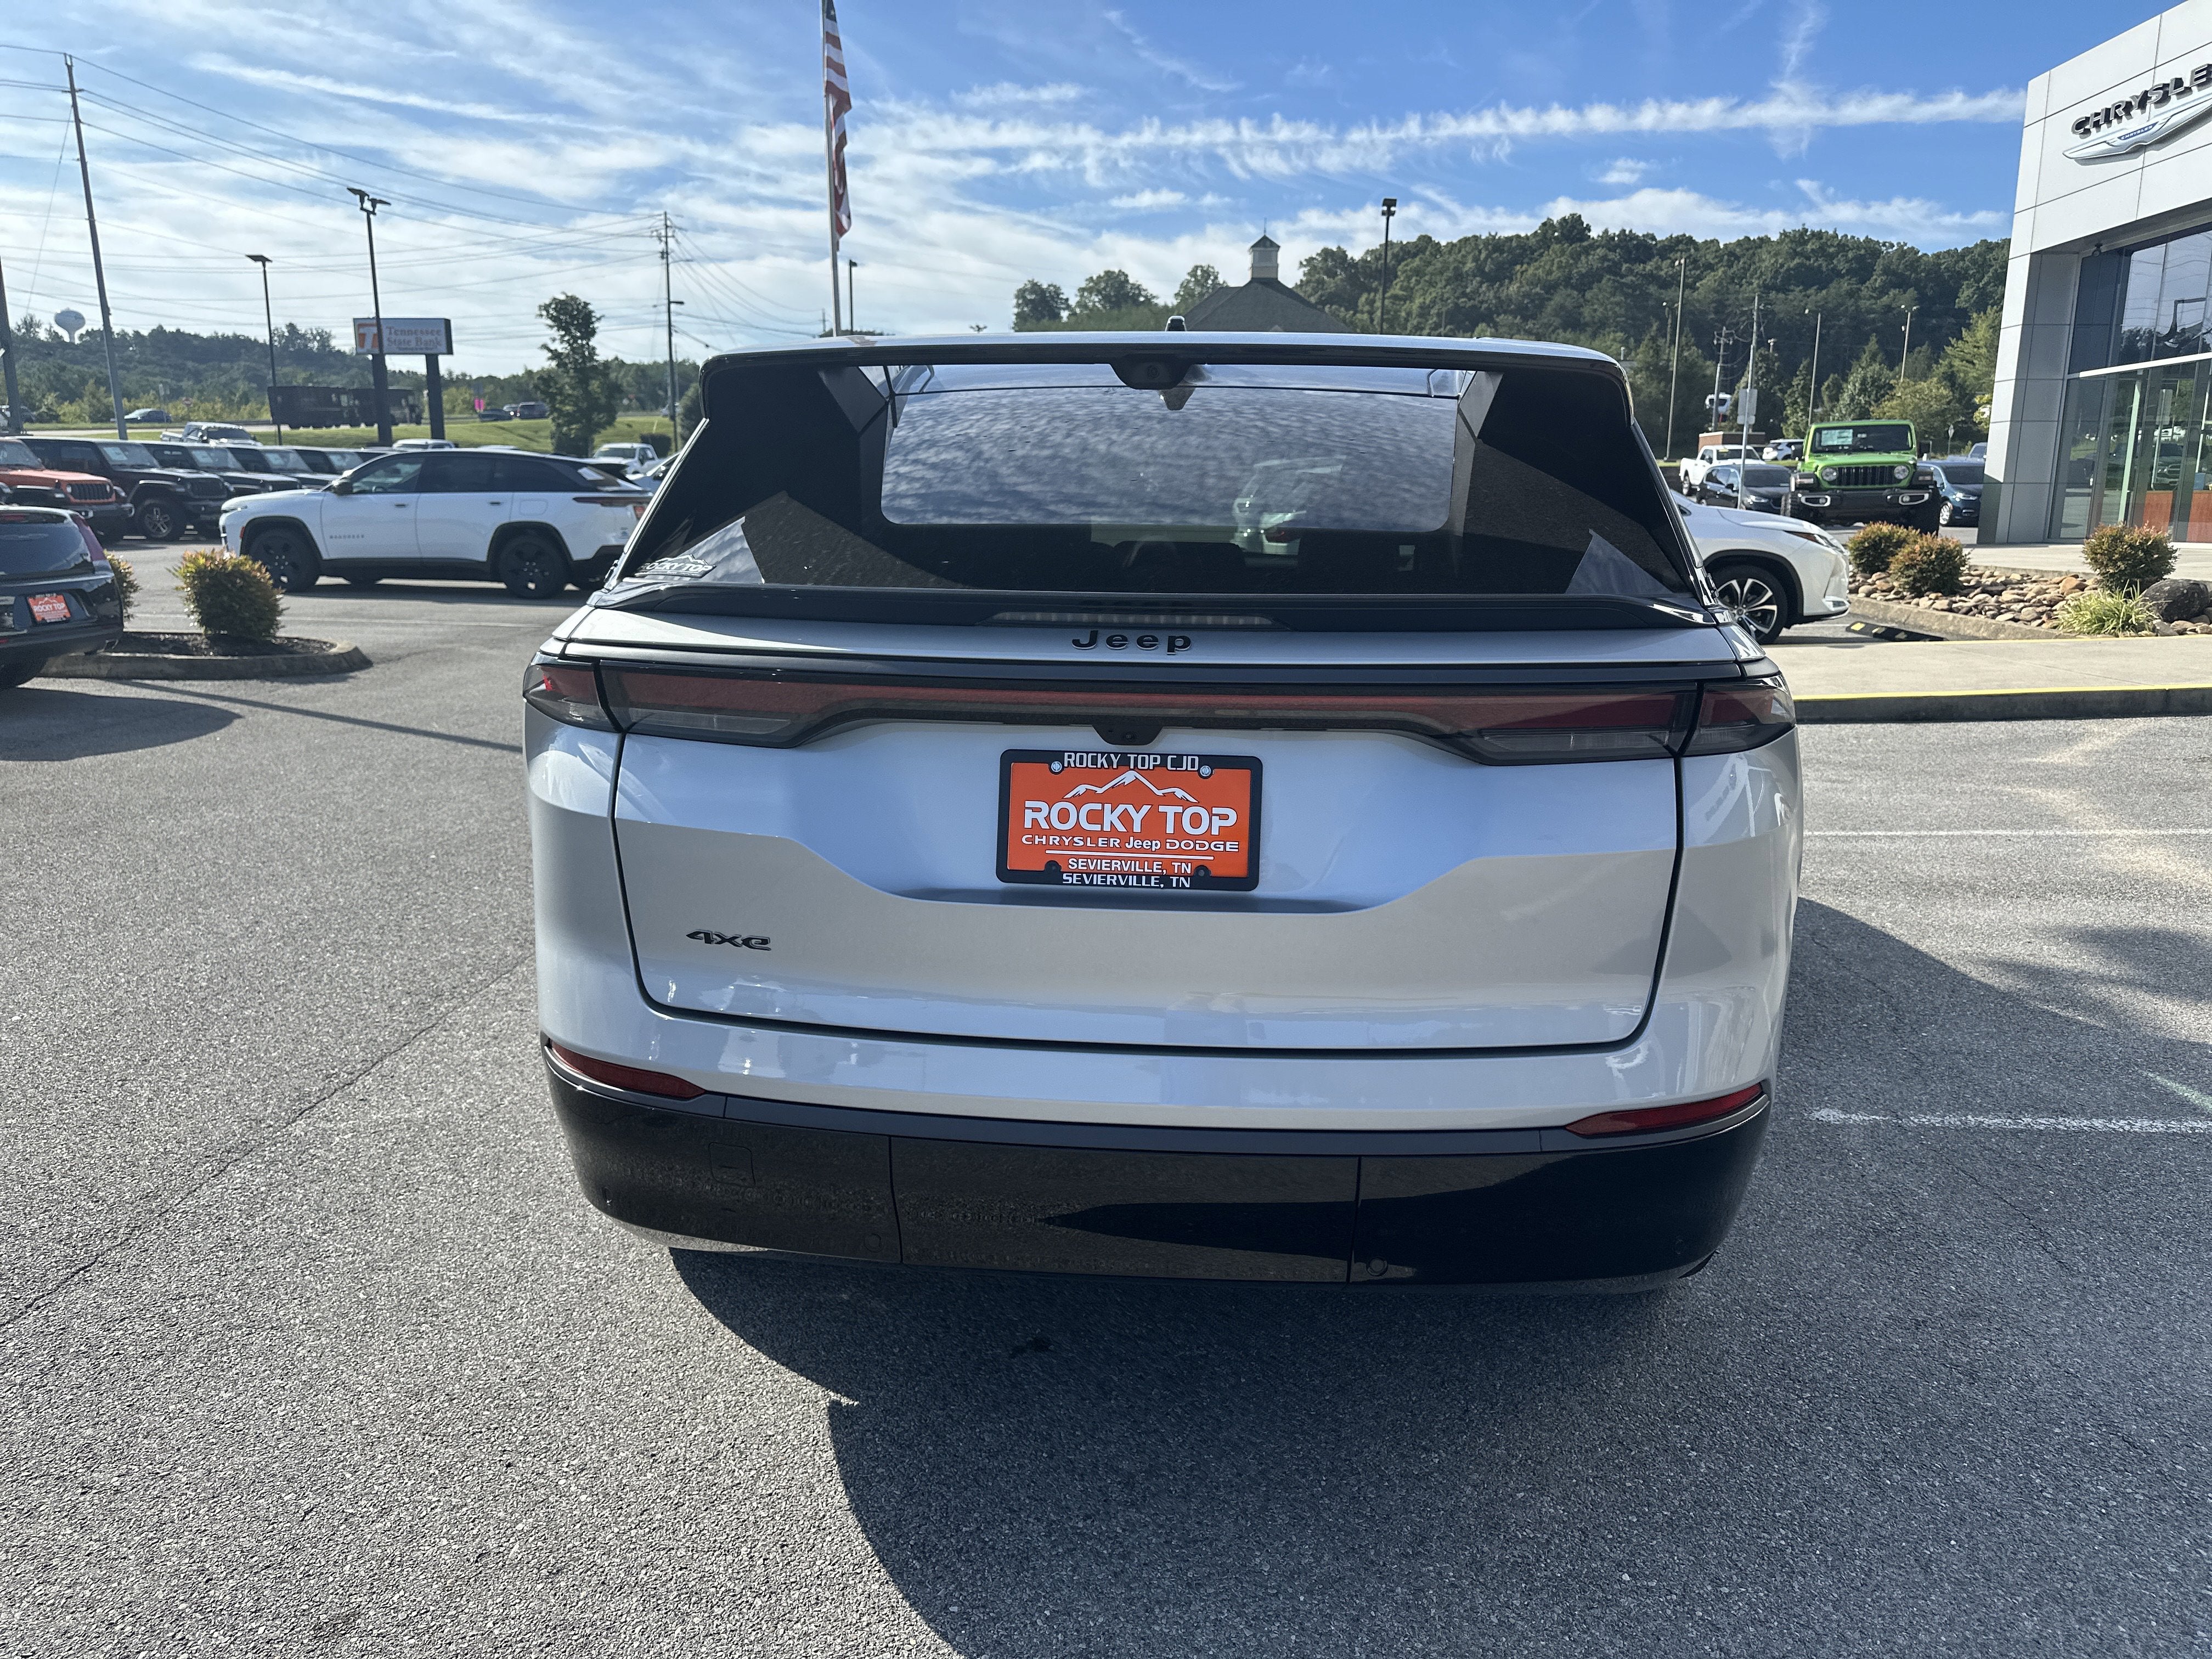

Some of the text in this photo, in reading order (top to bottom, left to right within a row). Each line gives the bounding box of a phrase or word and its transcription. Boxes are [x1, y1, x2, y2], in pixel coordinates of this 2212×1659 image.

[2071, 62, 2212, 136] CHRYSLE
[386, 326, 441, 336] Tennessee
[387, 336, 441, 347] State Bank
[683, 563, 713, 572] TOP
[1071, 630, 1192, 654] Jeep
[1064, 752, 1199, 771] ROCKY TOP CJD
[1024, 800, 1237, 836] ROCKY TOP
[1022, 834, 1239, 853] CHRYSLER Jeep DODGE
[1068, 858, 1191, 874] SEVIERVILLE, TN
[1062, 873, 1190, 889] SEVIERVILLE, TN
